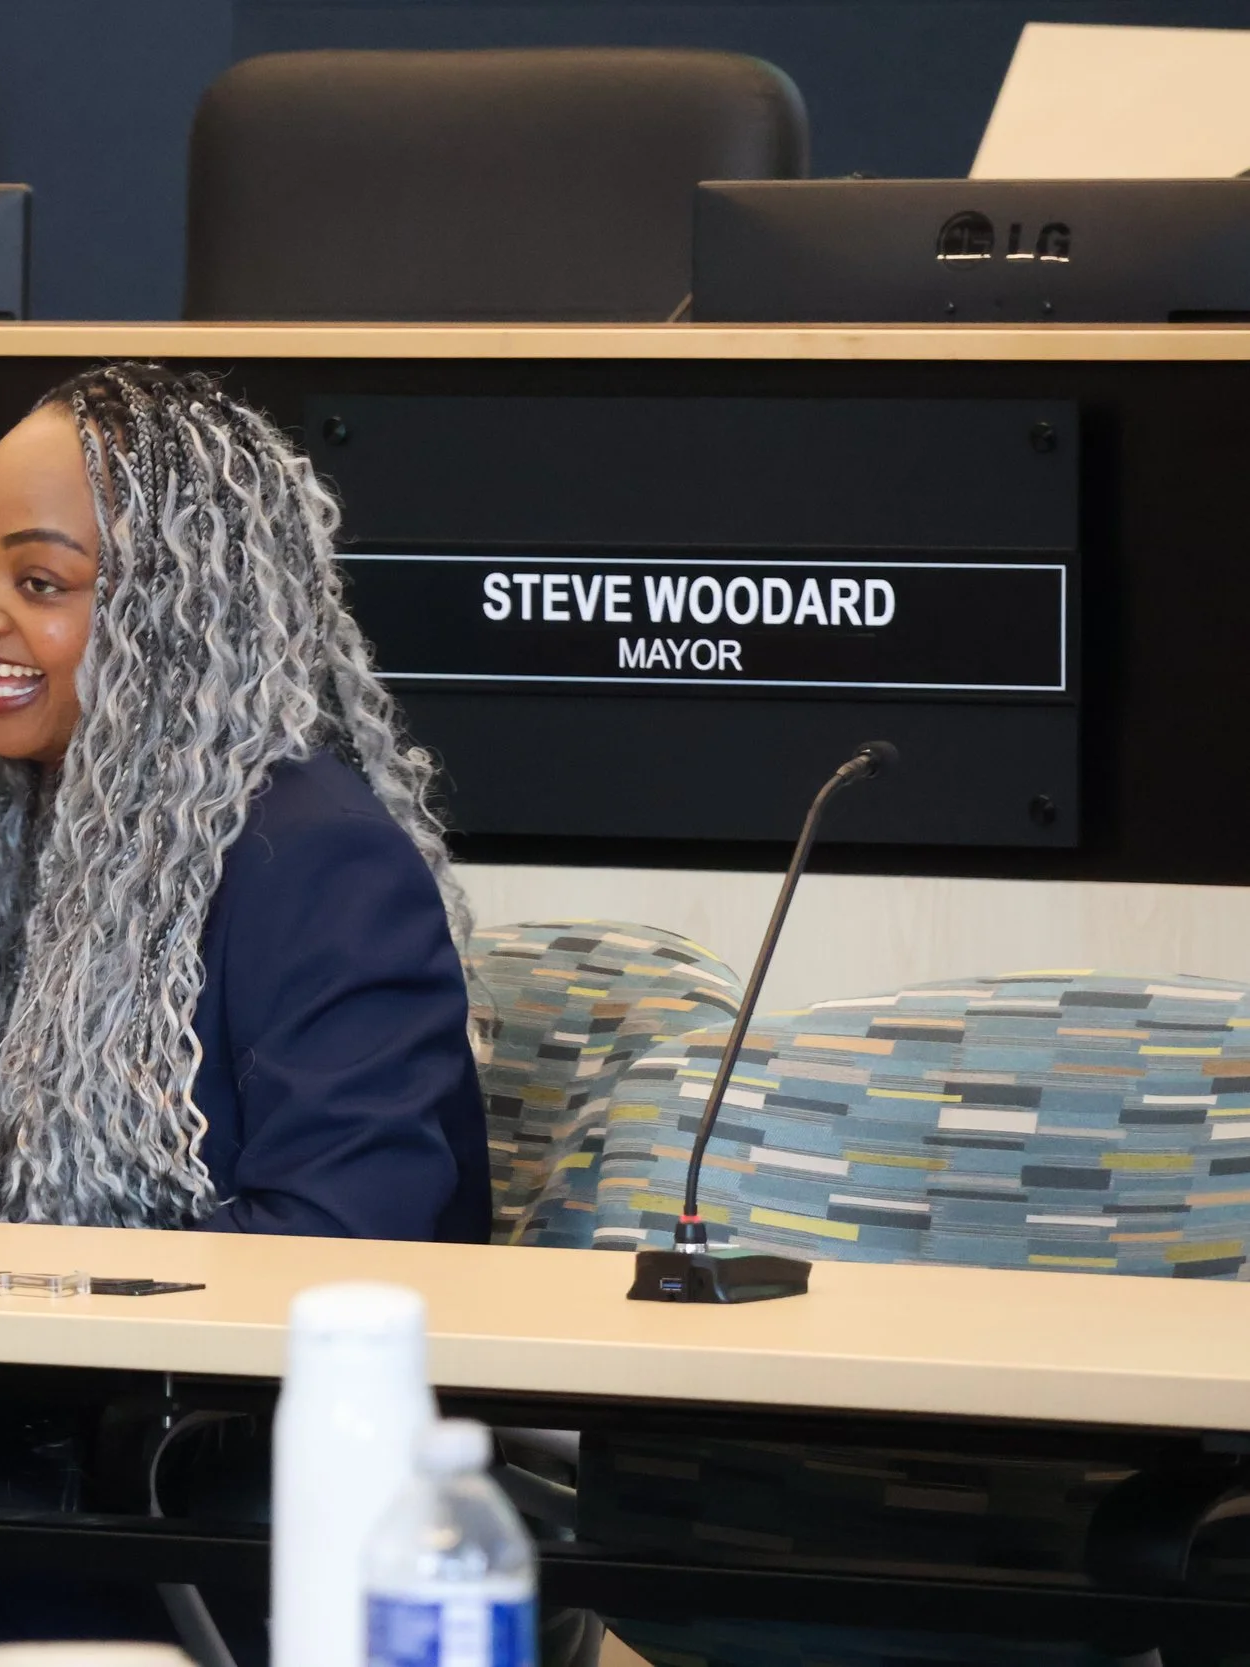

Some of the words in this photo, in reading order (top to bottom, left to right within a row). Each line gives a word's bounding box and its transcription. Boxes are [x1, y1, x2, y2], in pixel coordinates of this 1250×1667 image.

[1005, 222, 1071, 262] LG
[482, 572, 633, 622] STEVE
[644, 576, 896, 627] WOODARD
[618, 638, 743, 671] MAYOR
